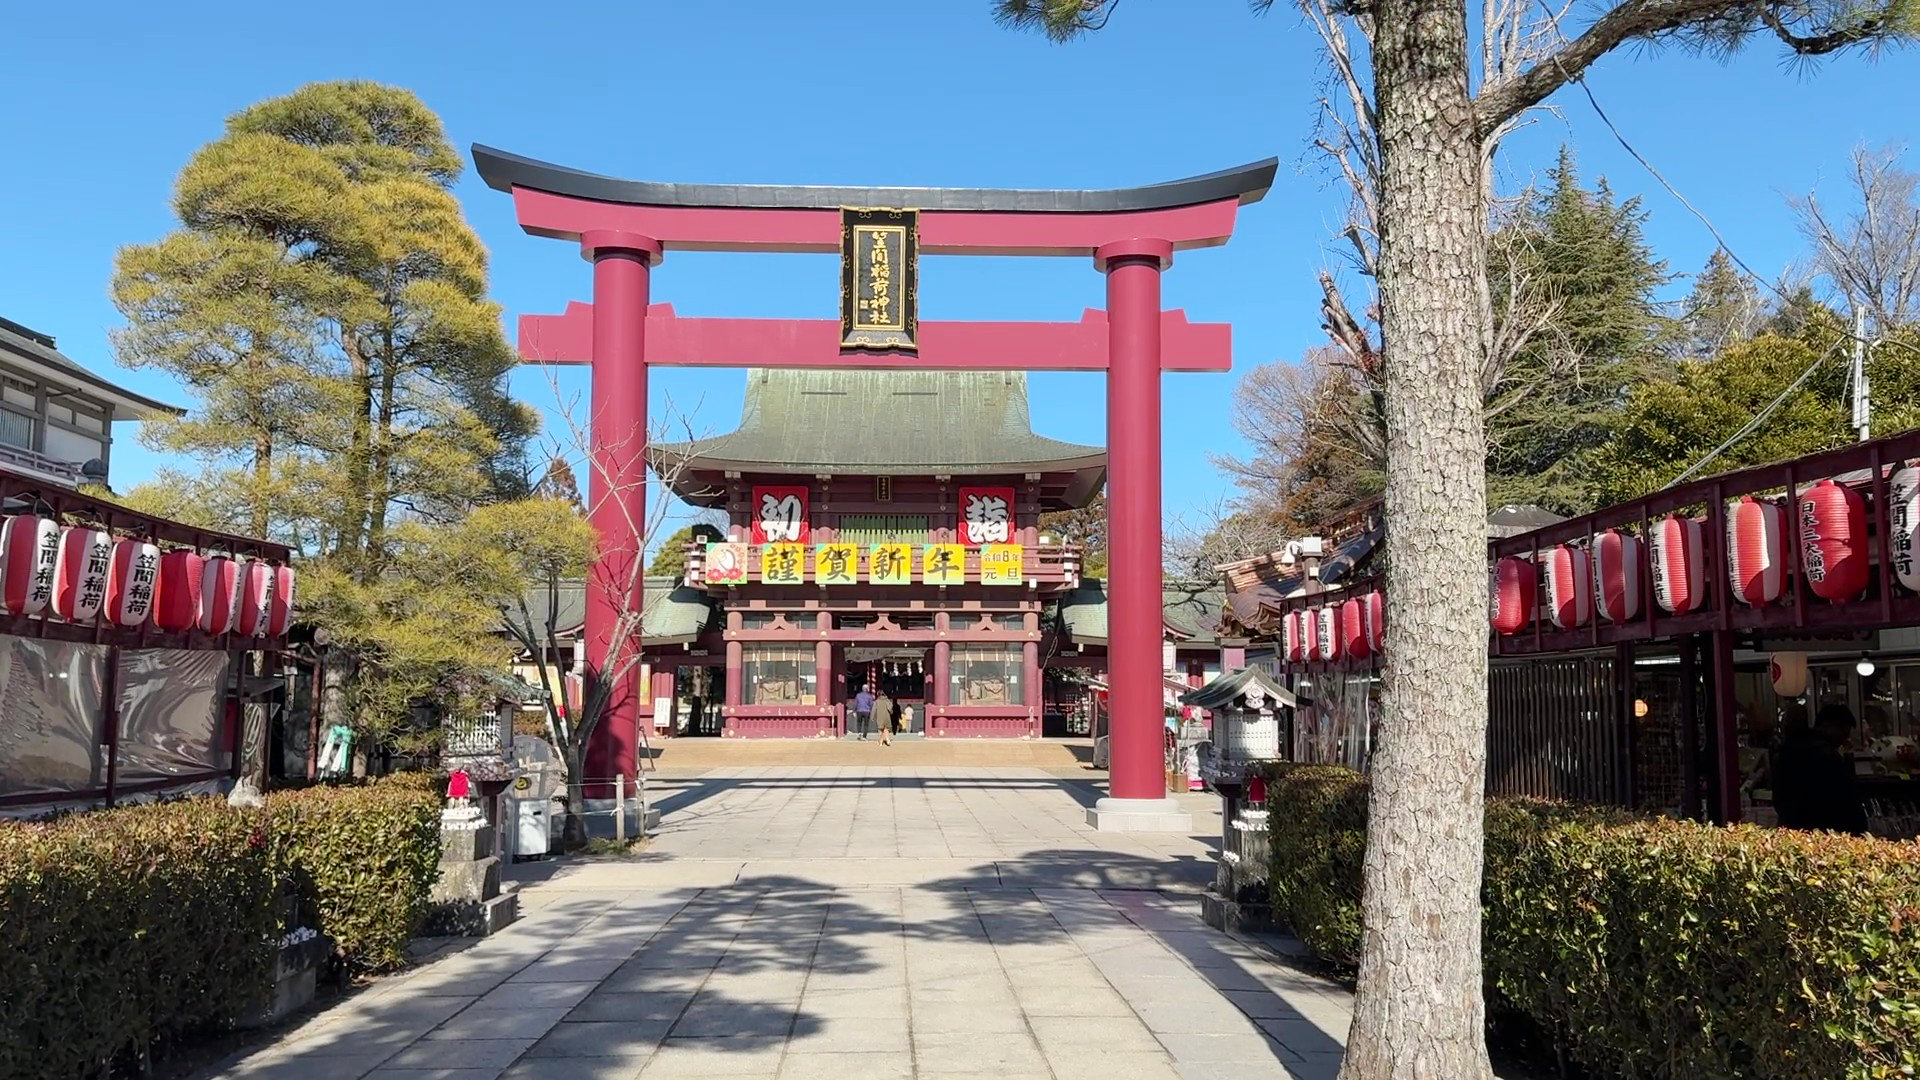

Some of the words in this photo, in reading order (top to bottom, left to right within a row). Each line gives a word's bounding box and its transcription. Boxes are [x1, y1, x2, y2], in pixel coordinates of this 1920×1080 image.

[869, 231, 891, 325] 笠間稲荷神社
[760, 492, 803, 543] 初
[79, 543, 110, 610] 笠間稲荷
[766, 545, 961, 582] 謹賀新年
[983, 550, 1020, 562] 令和8年
[984, 567, 1020, 580] 元旦
[126, 554, 157, 617] 笠間稲荷
